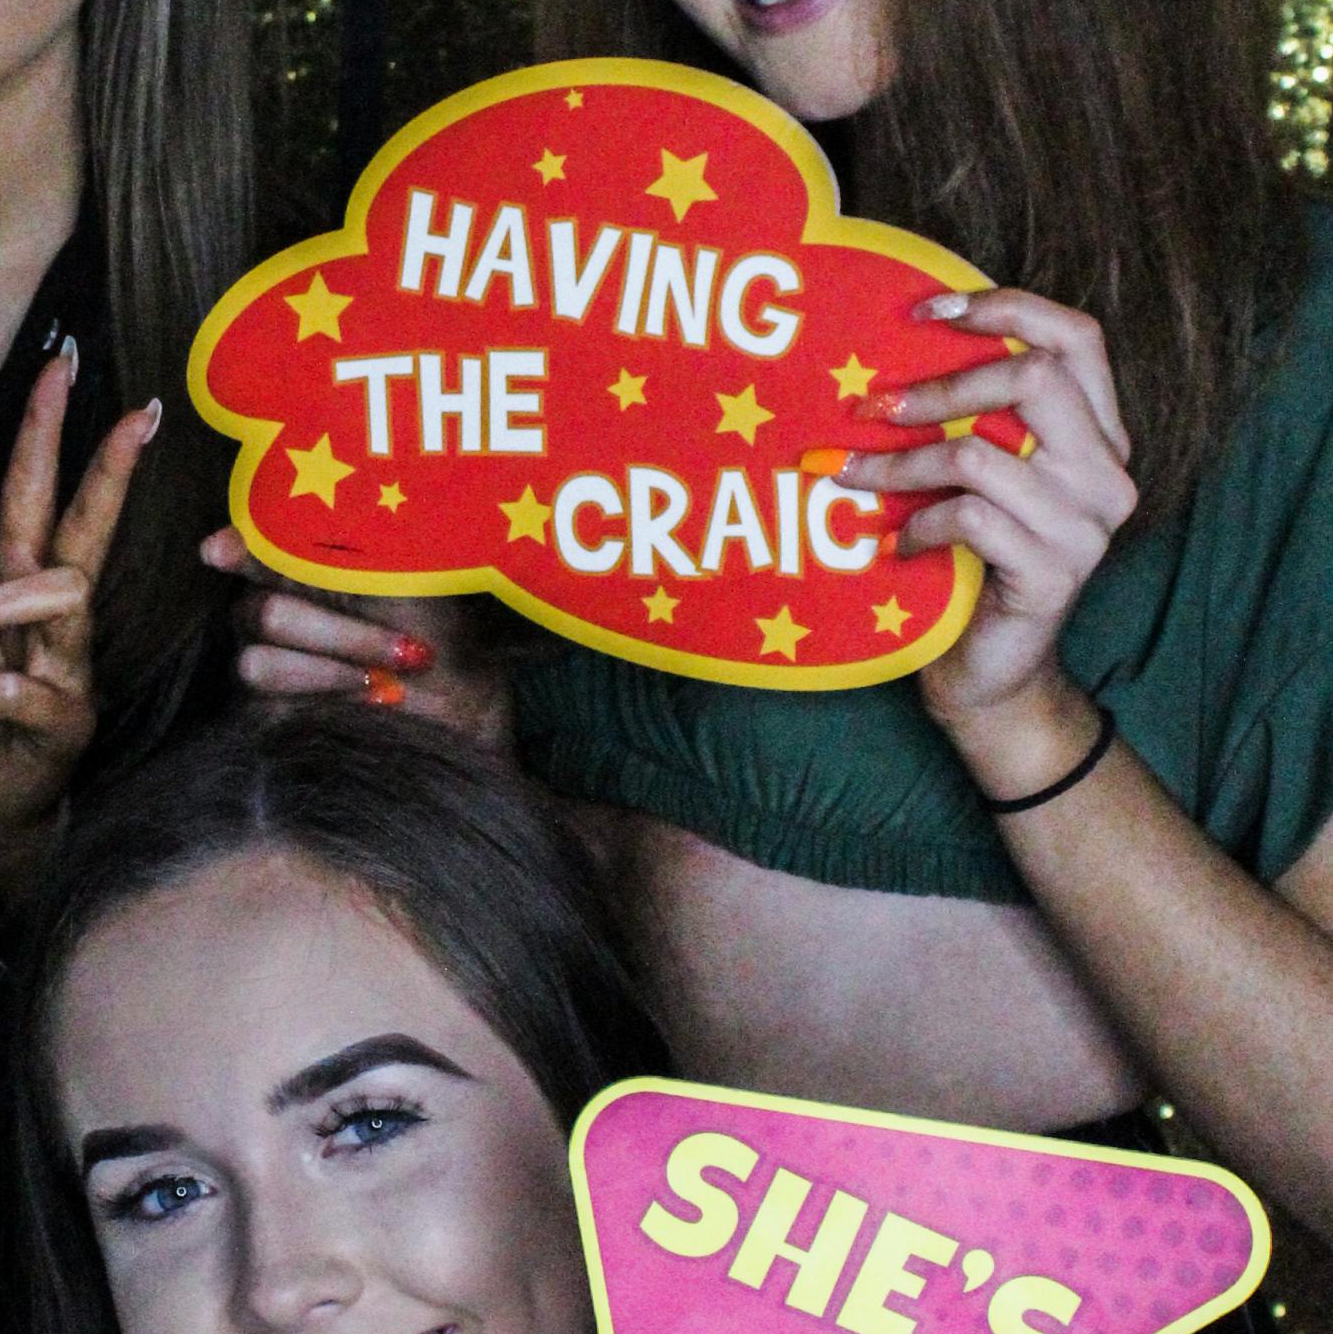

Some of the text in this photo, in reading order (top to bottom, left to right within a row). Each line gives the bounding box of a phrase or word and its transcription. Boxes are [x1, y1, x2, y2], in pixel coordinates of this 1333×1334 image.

[400, 190, 801, 357] HAVING
[334, 350, 546, 455] THE
[553, 466, 880, 577] CRAIC
